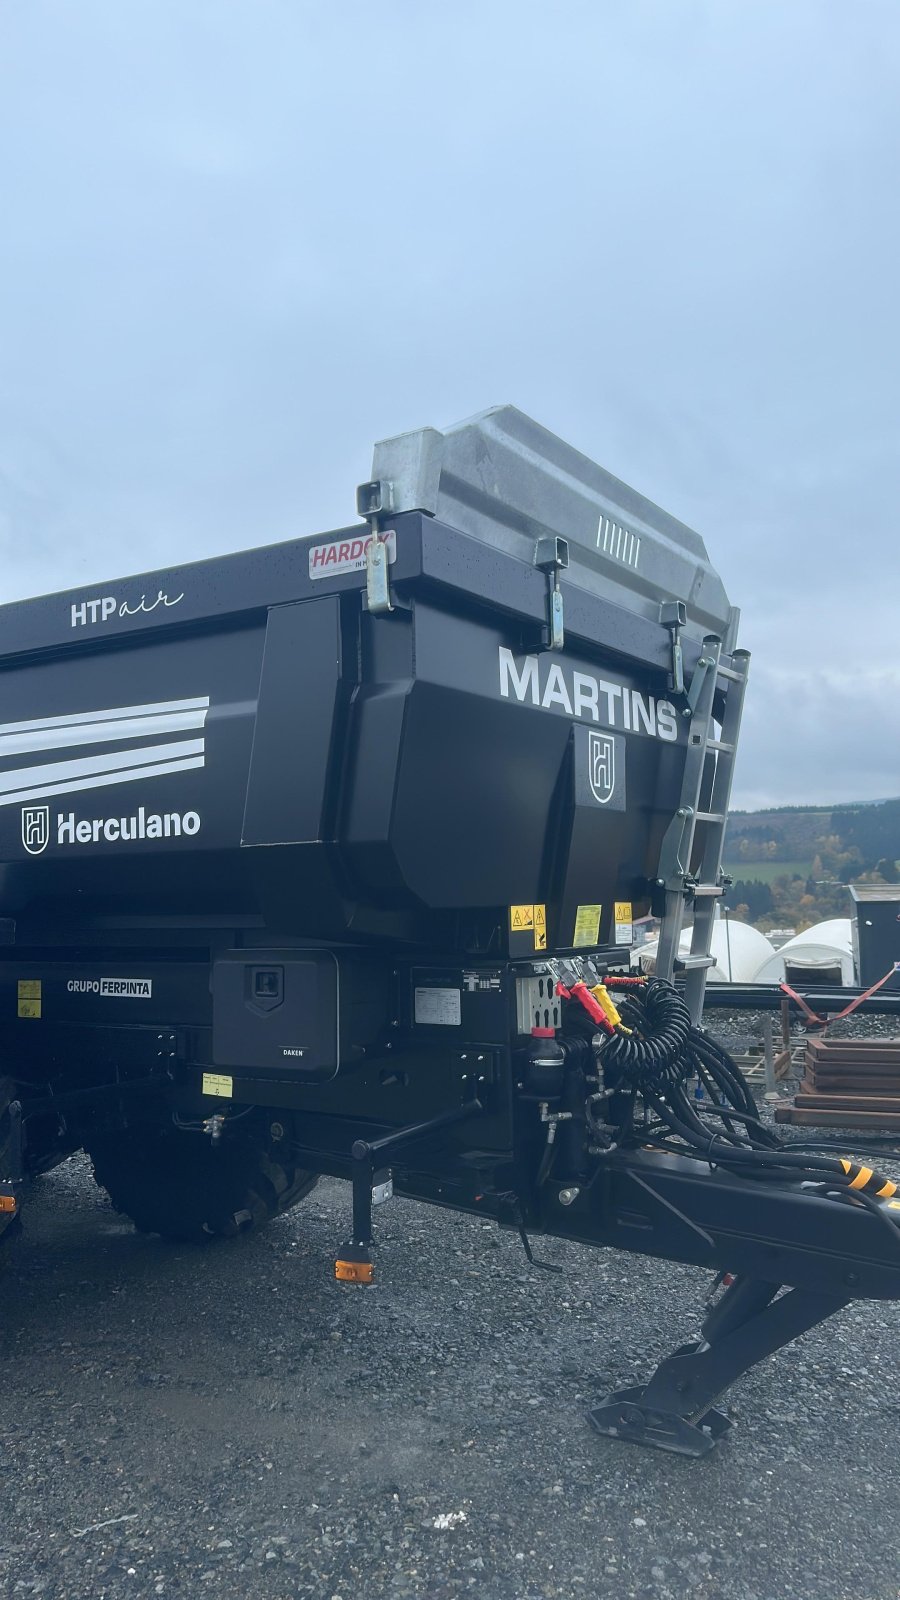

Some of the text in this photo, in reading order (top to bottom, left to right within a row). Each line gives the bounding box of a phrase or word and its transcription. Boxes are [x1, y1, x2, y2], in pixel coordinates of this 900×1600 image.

[498, 645, 678, 742] MARTINS
[57, 806, 201, 844] Herculano
[66, 979, 150, 996] GRUPO FERPINTA
[283, 1049, 304, 1057] DAKEN
